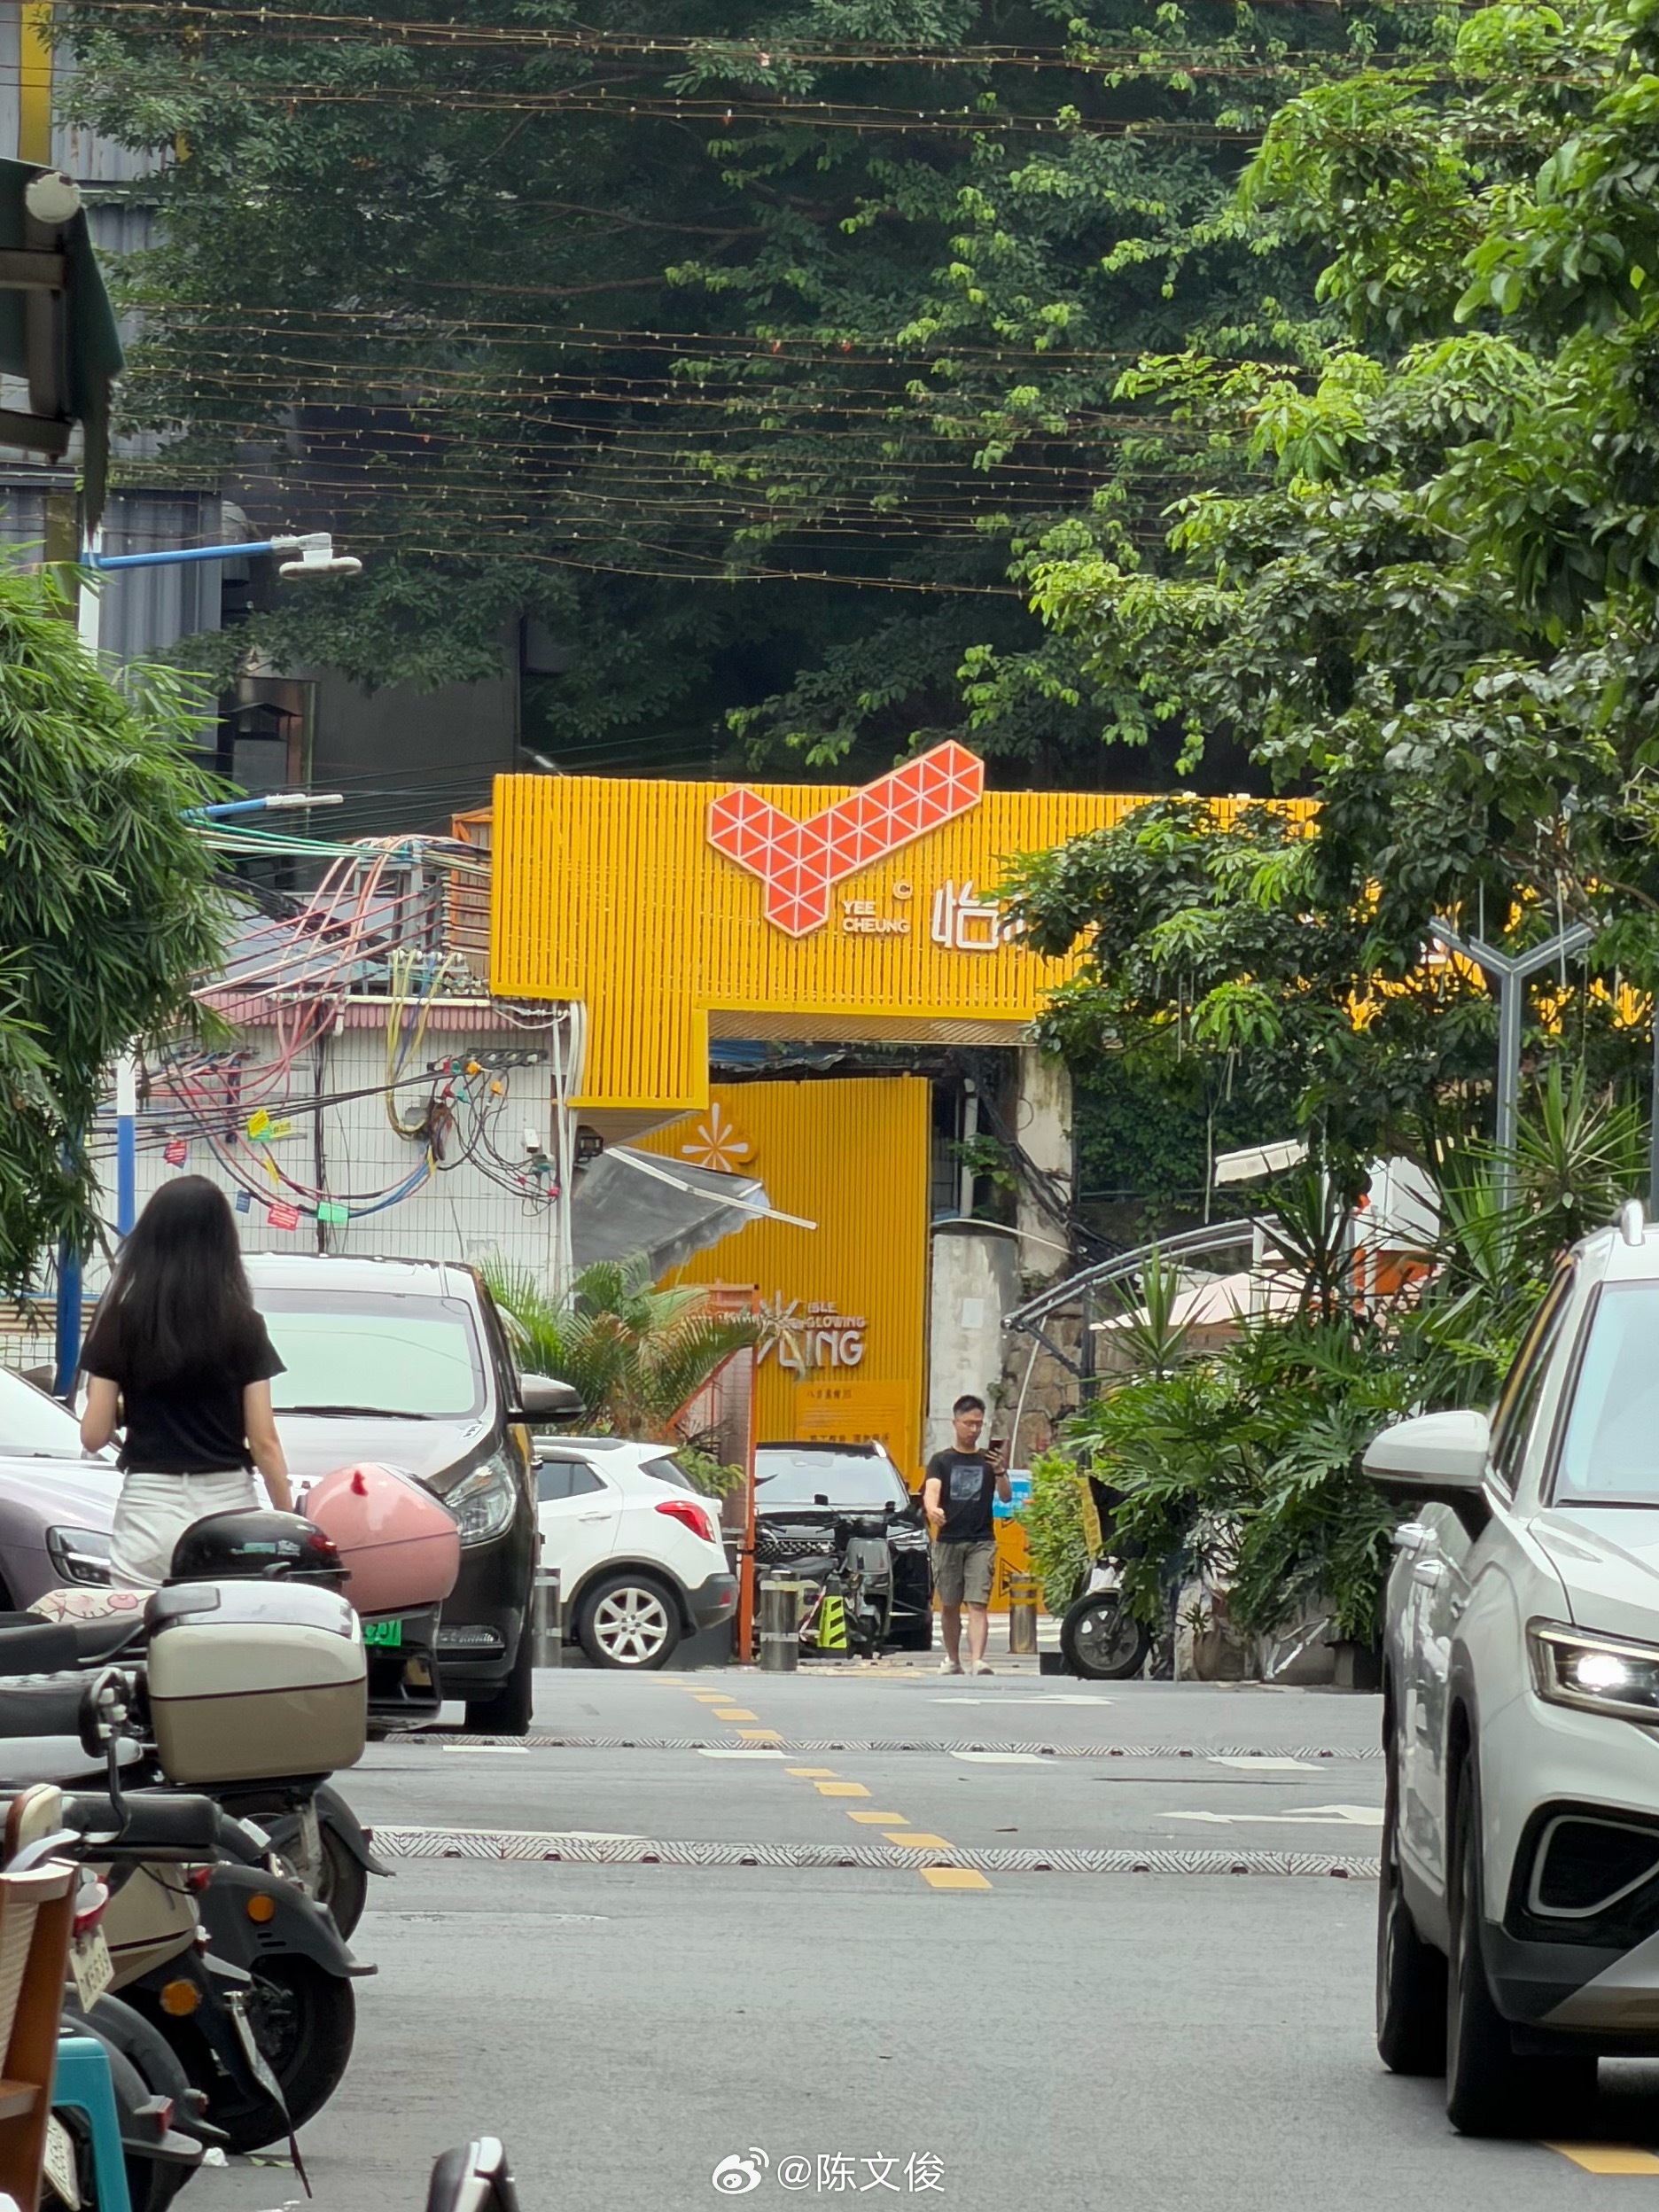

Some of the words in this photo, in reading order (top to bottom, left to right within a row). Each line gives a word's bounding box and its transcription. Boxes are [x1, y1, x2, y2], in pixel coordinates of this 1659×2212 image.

[842, 900, 876, 915] YEE
[931, 878, 1026, 950] 怡
[843, 917, 911, 933] CHEUNG
[806, 1315, 866, 1328] GLOWING
[779, 1330, 864, 1367] LING
